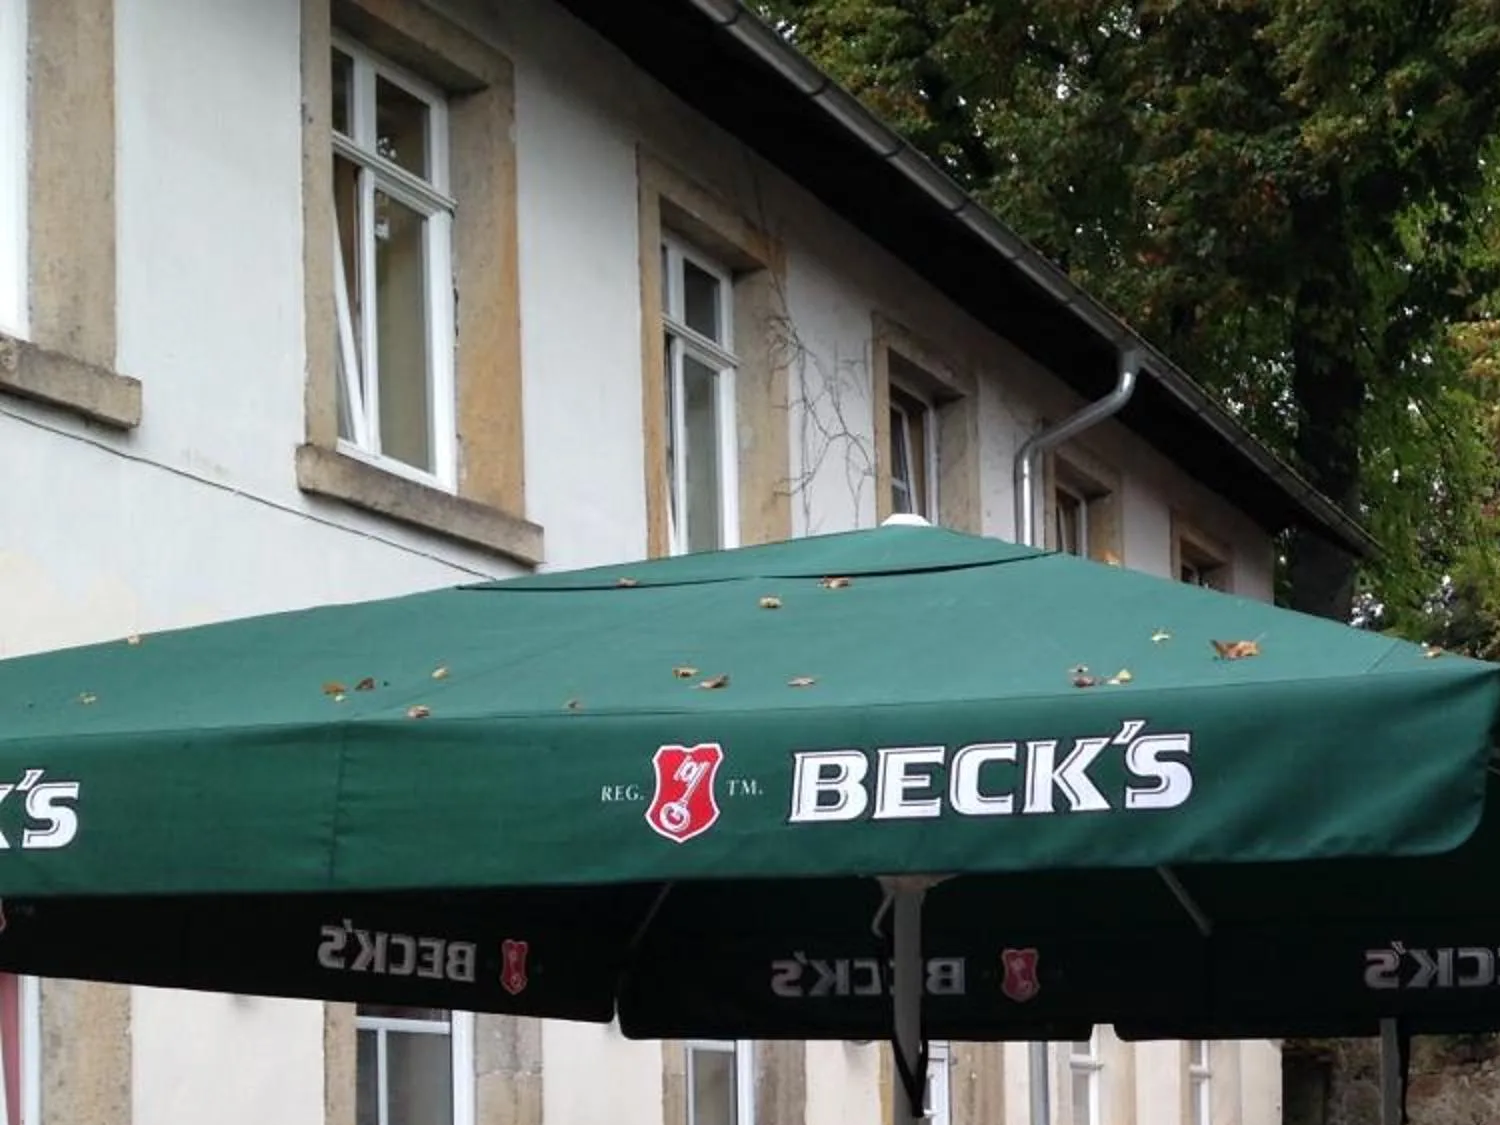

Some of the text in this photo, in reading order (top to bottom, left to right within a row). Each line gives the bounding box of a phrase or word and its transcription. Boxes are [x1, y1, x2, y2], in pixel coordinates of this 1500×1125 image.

[601, 719, 1193, 823] REG. TM. BECK'S
